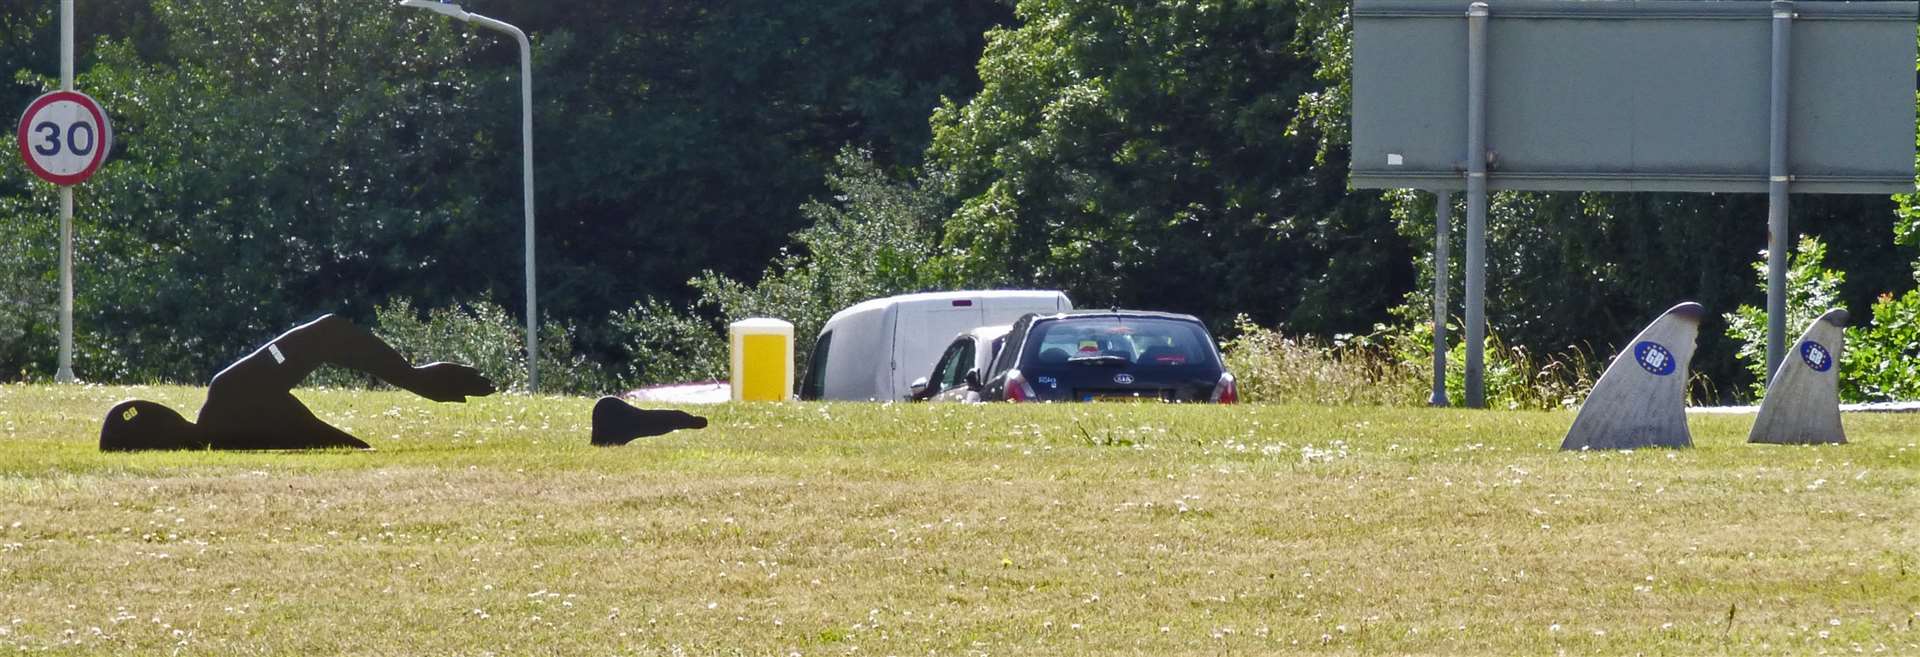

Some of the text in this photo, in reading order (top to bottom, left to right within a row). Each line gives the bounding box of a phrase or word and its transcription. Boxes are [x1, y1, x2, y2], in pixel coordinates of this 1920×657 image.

[35, 121, 94, 157] 30
[1646, 348, 1665, 368] GB
[1809, 347, 1824, 365] GB
[123, 406, 138, 421] GB
